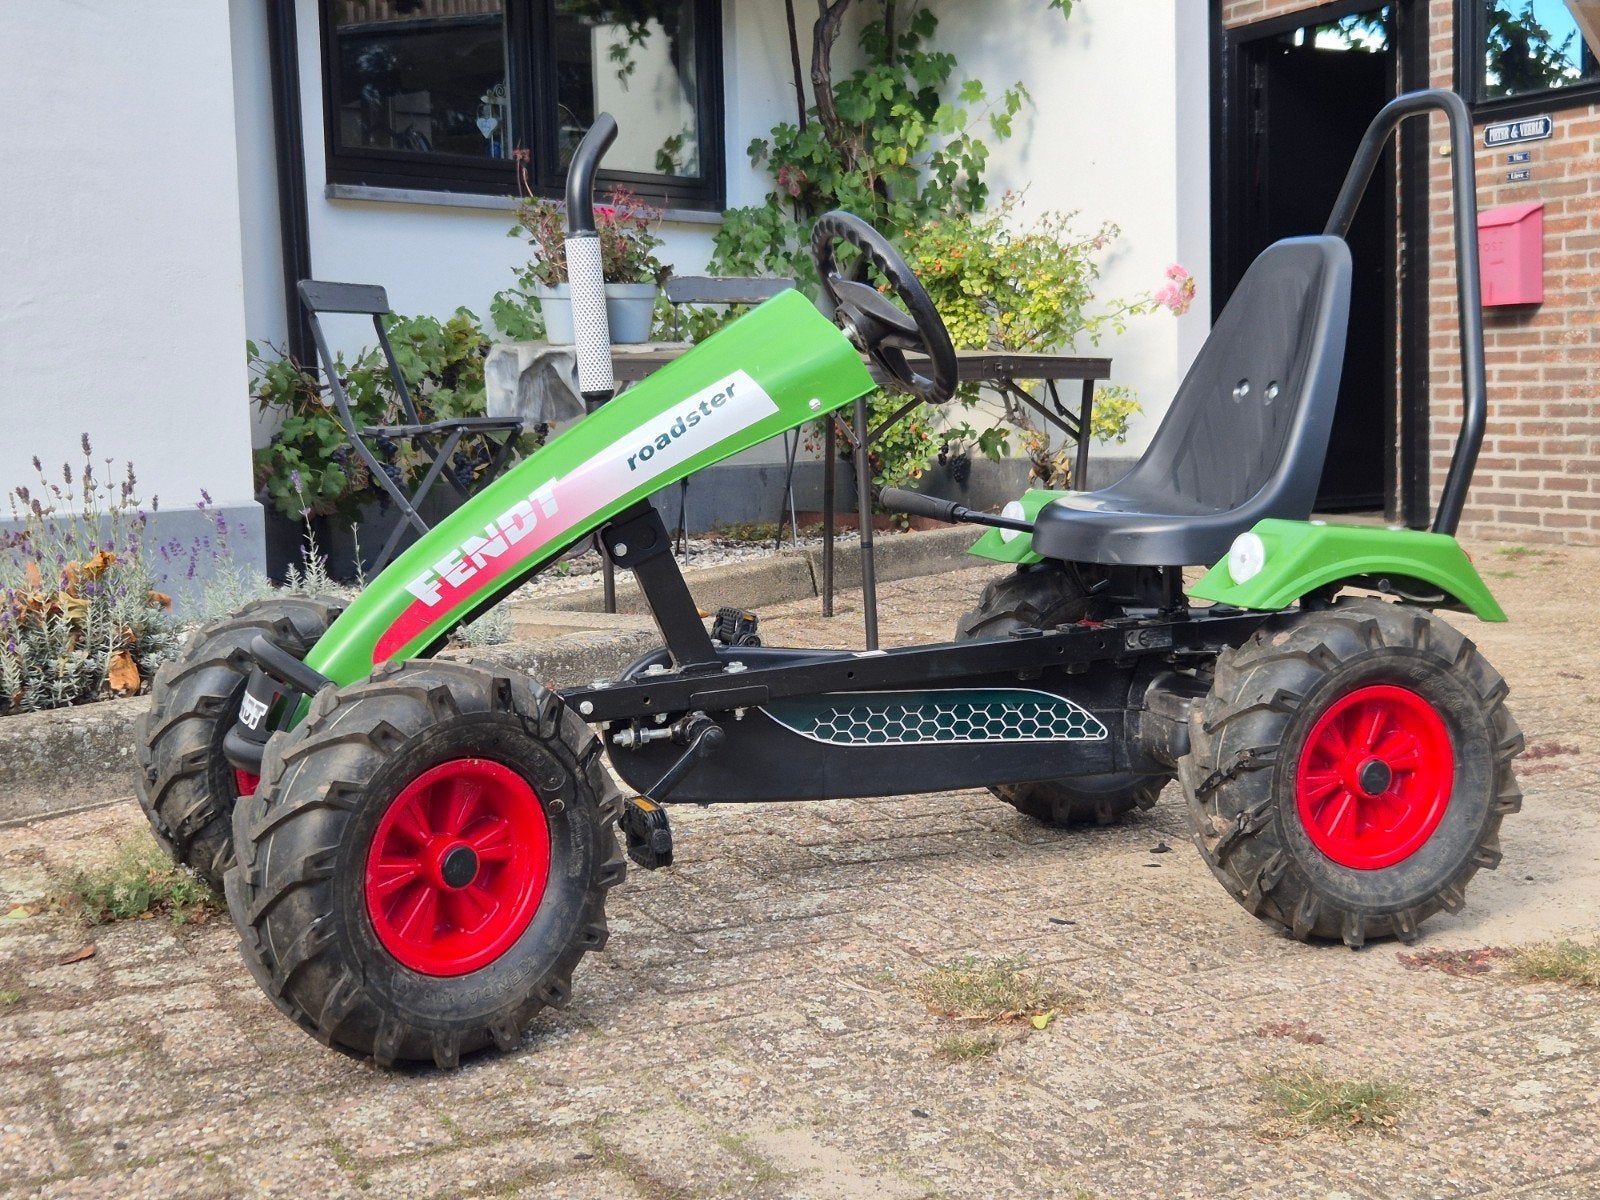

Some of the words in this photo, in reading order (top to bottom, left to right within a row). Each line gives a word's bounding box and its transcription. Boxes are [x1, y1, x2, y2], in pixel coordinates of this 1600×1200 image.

[1510, 124, 1519, 138] &
[627, 382, 735, 472] roadster
[404, 476, 559, 608] FENDT
